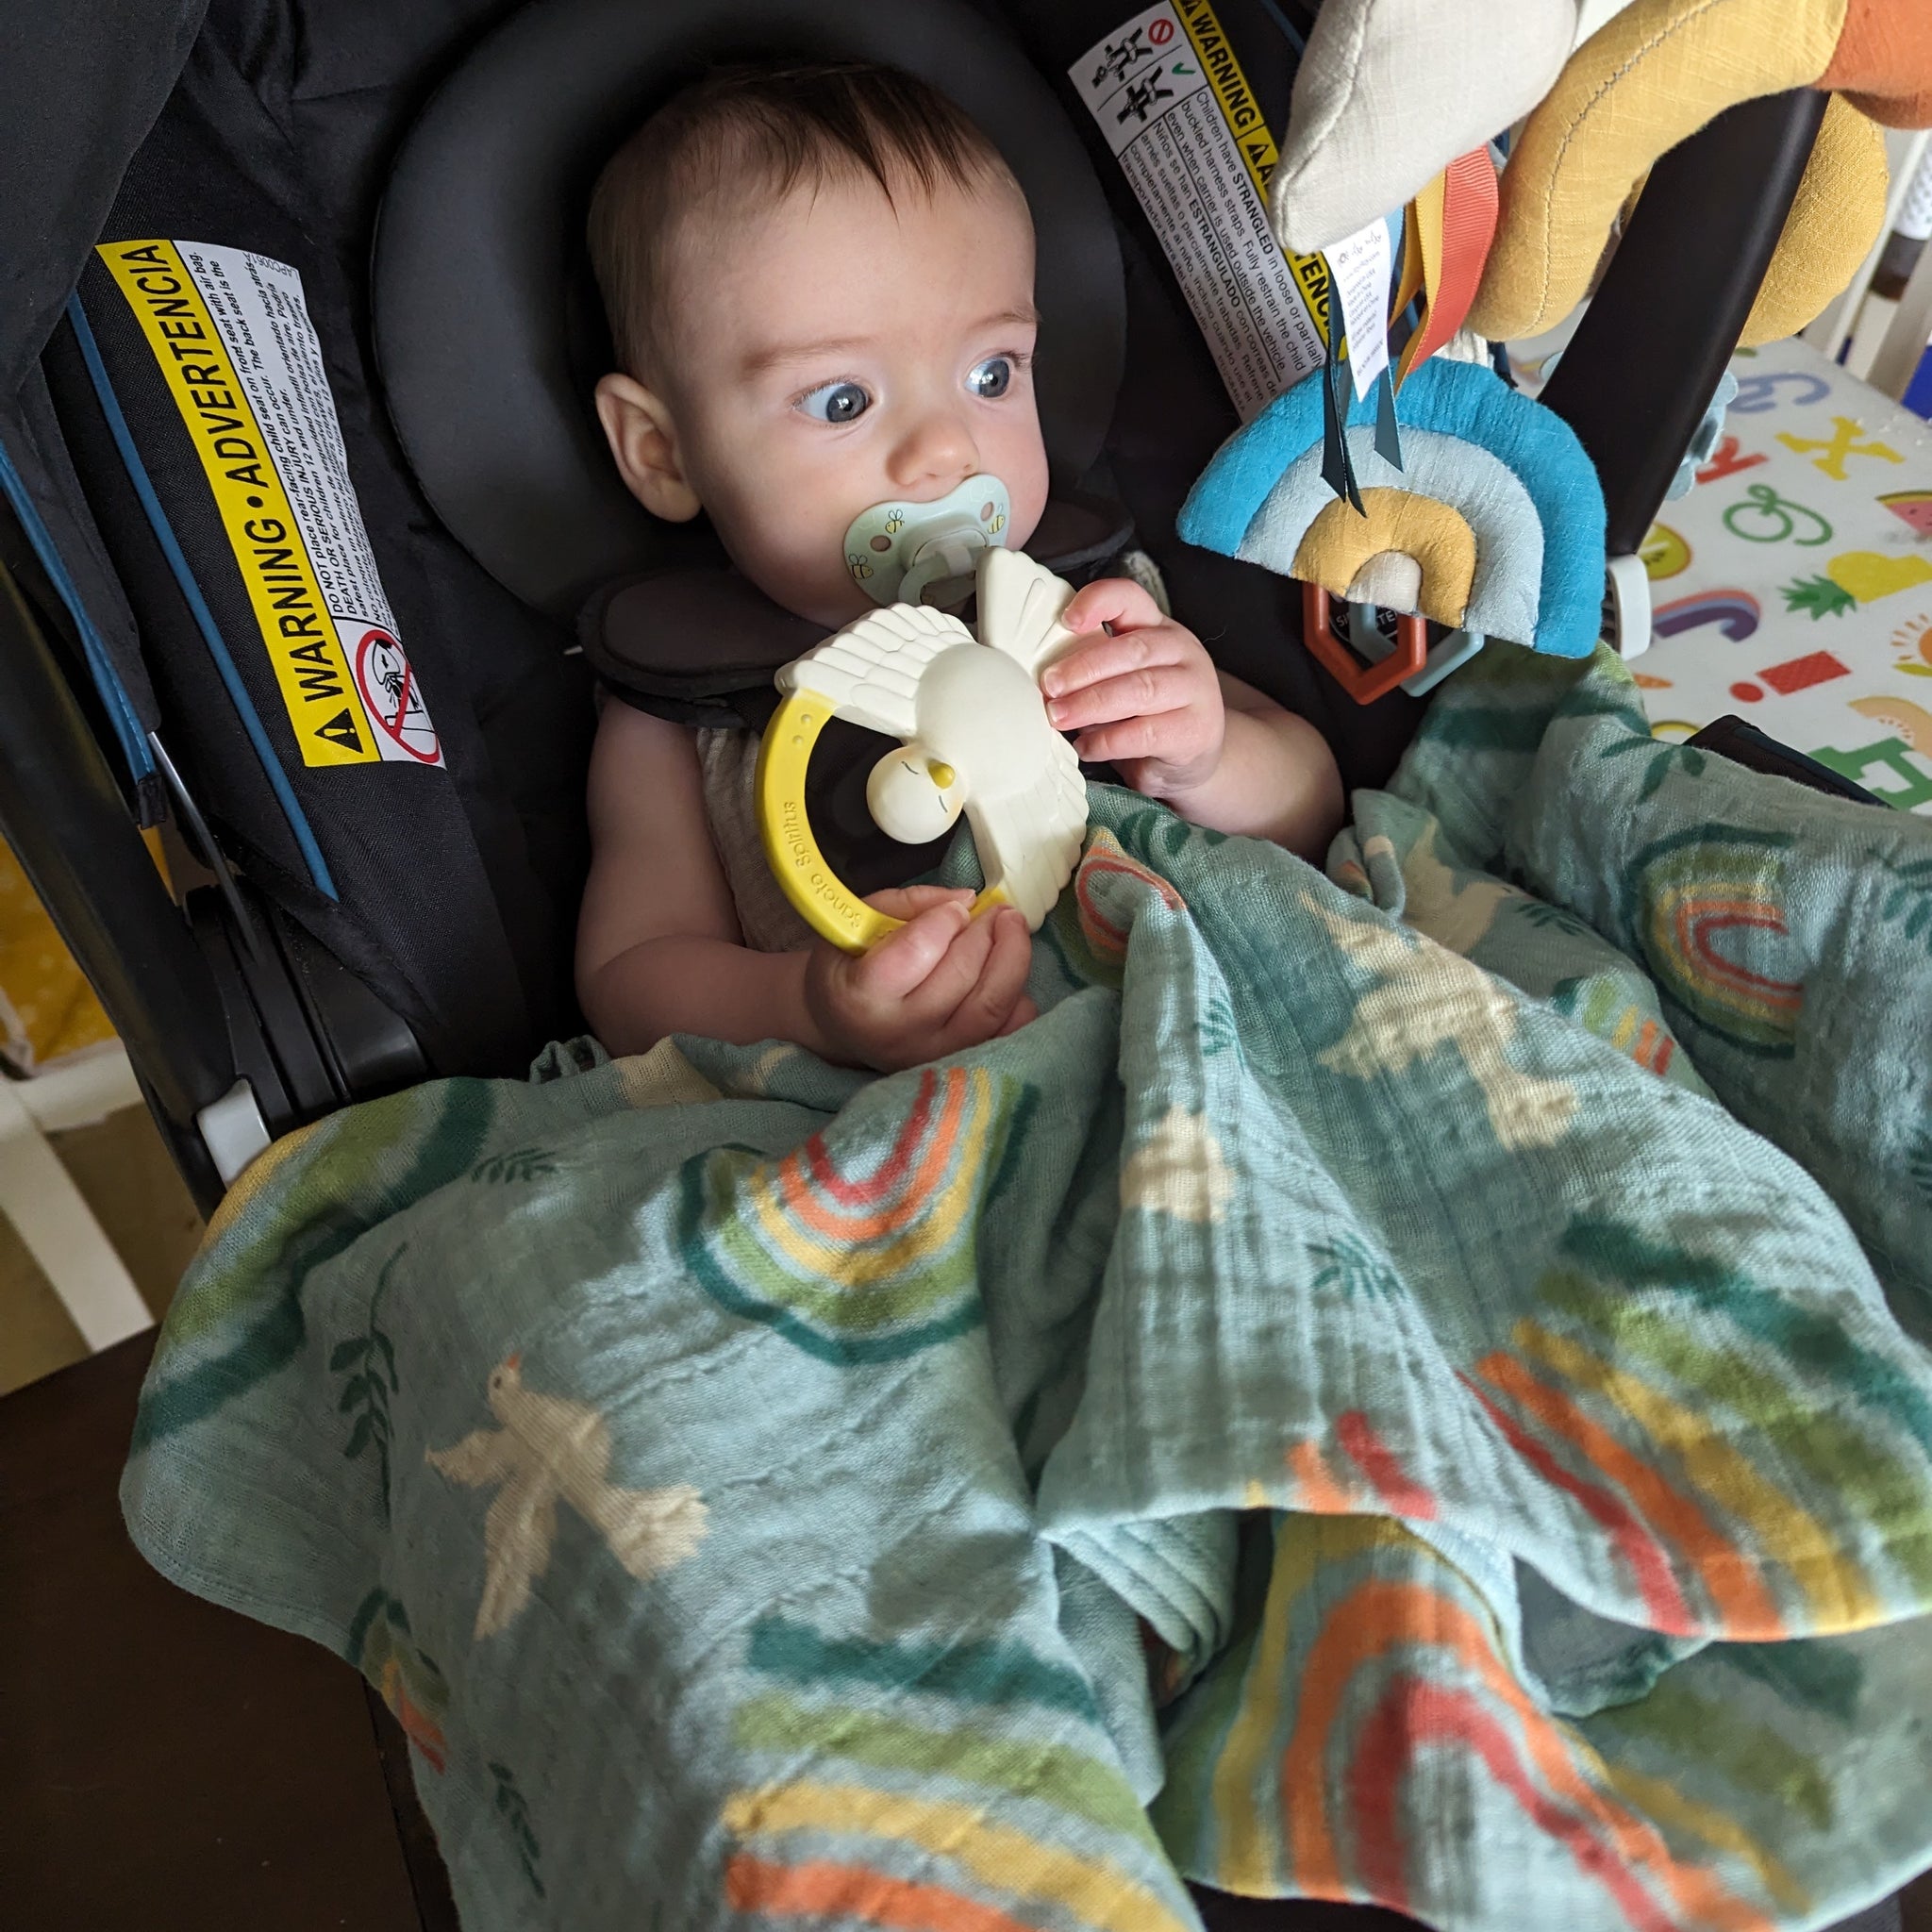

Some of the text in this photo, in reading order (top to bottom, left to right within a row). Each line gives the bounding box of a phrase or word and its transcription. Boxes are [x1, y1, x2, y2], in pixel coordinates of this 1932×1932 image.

[1191, 13, 1255, 127] WARNING
[1119, 153, 1162, 229] transportador
[1174, 262, 1186, 281] del
[1196, 92, 1223, 142] Children
[1218, 141, 1237, 173] have
[1233, 173, 1274, 254] STRANGLED
[1267, 255, 1278, 270] in
[1274, 269, 1293, 305] loose
[1290, 307, 1301, 320] or
[1153, 122, 1173, 158] Niños
[1169, 158, 1181, 174] se
[1178, 174, 1191, 199] han
[1189, 199, 1241, 308] ESTRANGULADO
[1236, 310, 1250, 334] con
[1246, 334, 1270, 379] correas
[1158, 168, 1180, 210] sueltas
[1177, 210, 1185, 221] o
[1181, 222, 1219, 297] parcialmente
[1167, 112, 1285, 375] even when carrier is used outside the vehicle.
[1181, 100, 1307, 372] buckled harness straps. Fully restrain the child
[244, 259, 263, 288] atrás
[1129, 145, 1175, 231] completamente
[1173, 234, 1183, 245] al
[1193, 277, 1215, 320] incluso
[1212, 322, 1235, 366] cuando
[258, 290, 275, 319] hacia
[266, 282, 288, 319] Podría
[271, 321, 294, 374] orientado
[283, 323, 295, 345] aire.
[291, 347, 301, 361] de
[296, 331, 313, 374] asiento
[288, 375, 309, 414] infantil
[296, 363, 312, 394] bolsa
[279, 389, 299, 425] under.
[308, 396, 320, 418] con
[189, 252, 344, 613] DO NOT place rear-facing child seat on front seat with air bag.
[209, 260, 358, 615] DEATH OR SERIOUS INJURY can occur. The back seat is the
[292, 426, 309, 451] and
[304, 415, 330, 473] seguridad
[120, 242, 342, 701] WARNING ADVERTENCIA
[303, 452, 315, 465] 12
[311, 471, 333, 520] children
[326, 475, 336, 490] de
[329, 523, 341, 541] for
[333, 492, 351, 535] asiento
[338, 543, 356, 577] place
[348, 537, 358, 552] un
[349, 579, 369, 617] safest
[354, 555, 375, 601] coloque
[371, 604, 382, 622] NO
